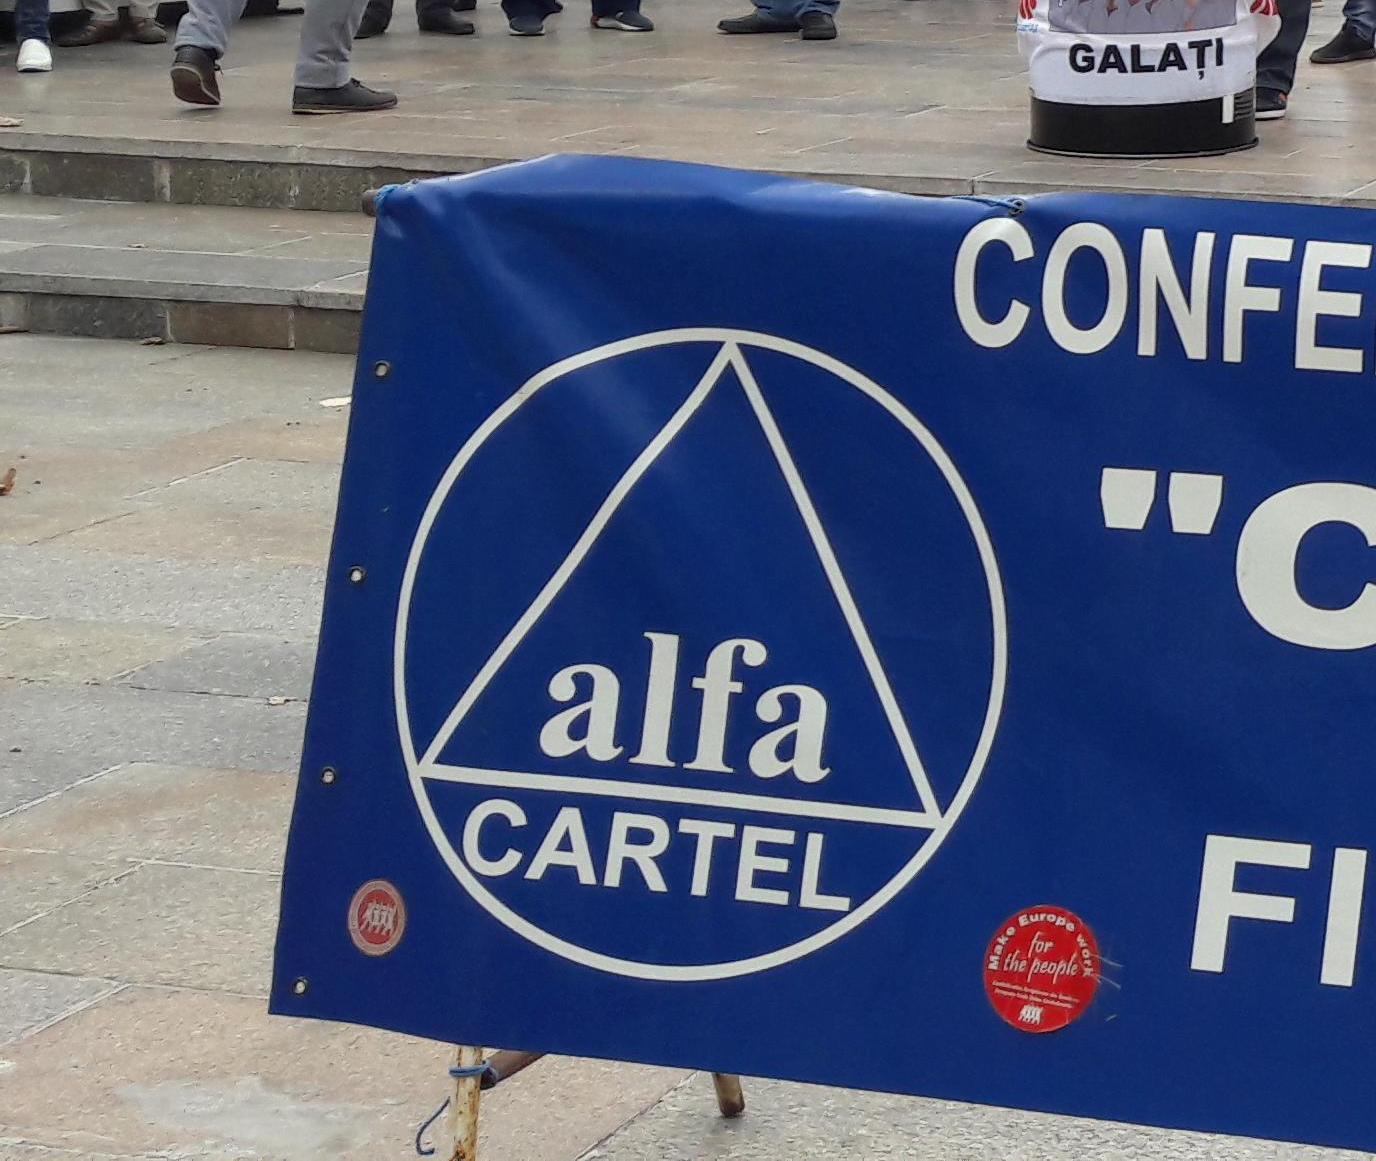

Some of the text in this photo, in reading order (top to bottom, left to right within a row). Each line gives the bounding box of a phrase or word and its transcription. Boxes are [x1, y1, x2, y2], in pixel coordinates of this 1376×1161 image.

[1068, 37, 1225, 81] GALAȚI
[540, 631, 832, 783] alfa
[462, 798, 851, 912] CARTEL
[988, 926, 1016, 970] Make
[1018, 913, 1076, 931] Europe
[1028, 931, 1054, 958] for
[1003, 950, 1078, 984] the people
